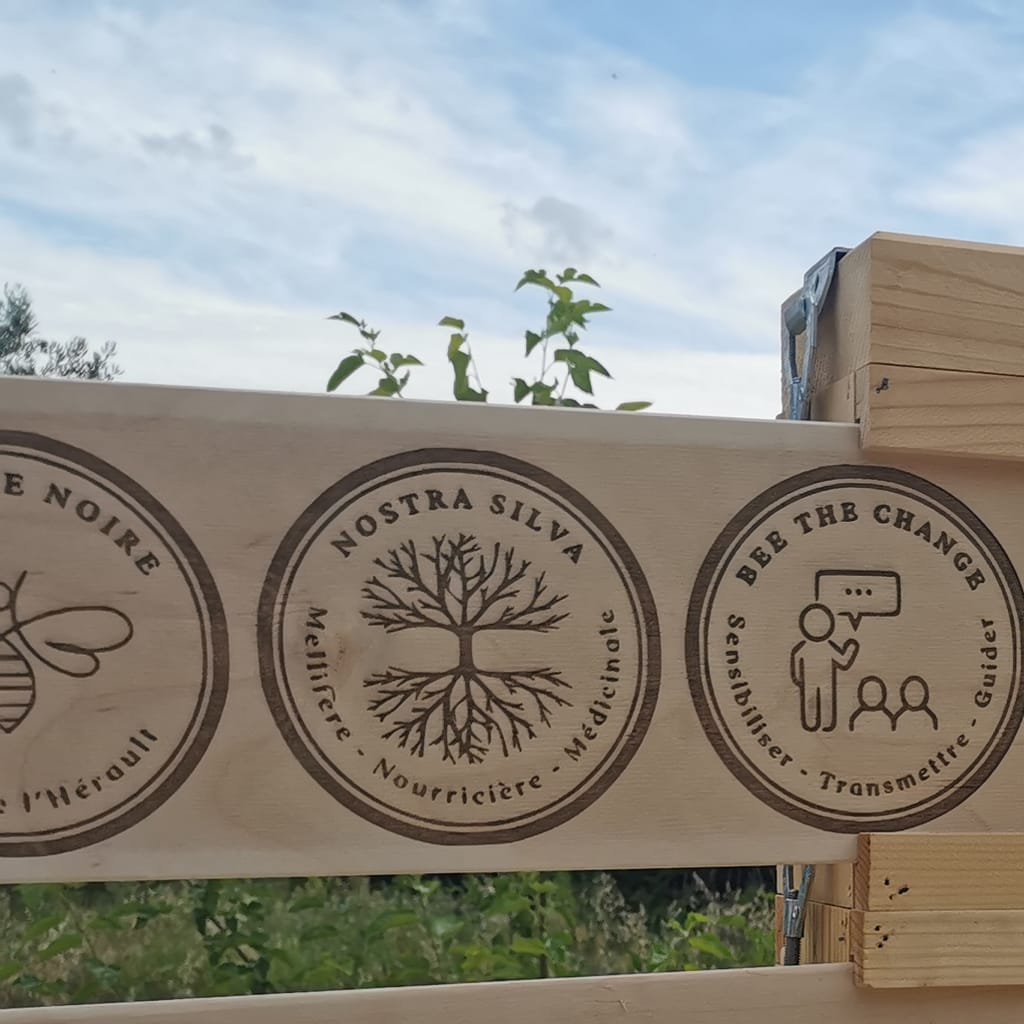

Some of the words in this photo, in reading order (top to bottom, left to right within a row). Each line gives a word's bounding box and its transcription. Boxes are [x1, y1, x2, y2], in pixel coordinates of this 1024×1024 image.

[42, 482, 161, 576] NOIRE
[329, 487, 474, 559] NOSTRA
[489, 493, 584, 565] SILVA
[735, 530, 789, 587] BEE
[792, 501, 859, 535] THE
[872, 503, 986, 591] CHANGE
[372, 757, 543, 806] Nourricière
[563, 609, 621, 762] Médicinale
[724, 613, 794, 767] Sensibiliser
[819, 733, 970, 797] Transmettre
[974, 618, 998, 709] Guider
[22, 728, 158, 813] l'Hérault
